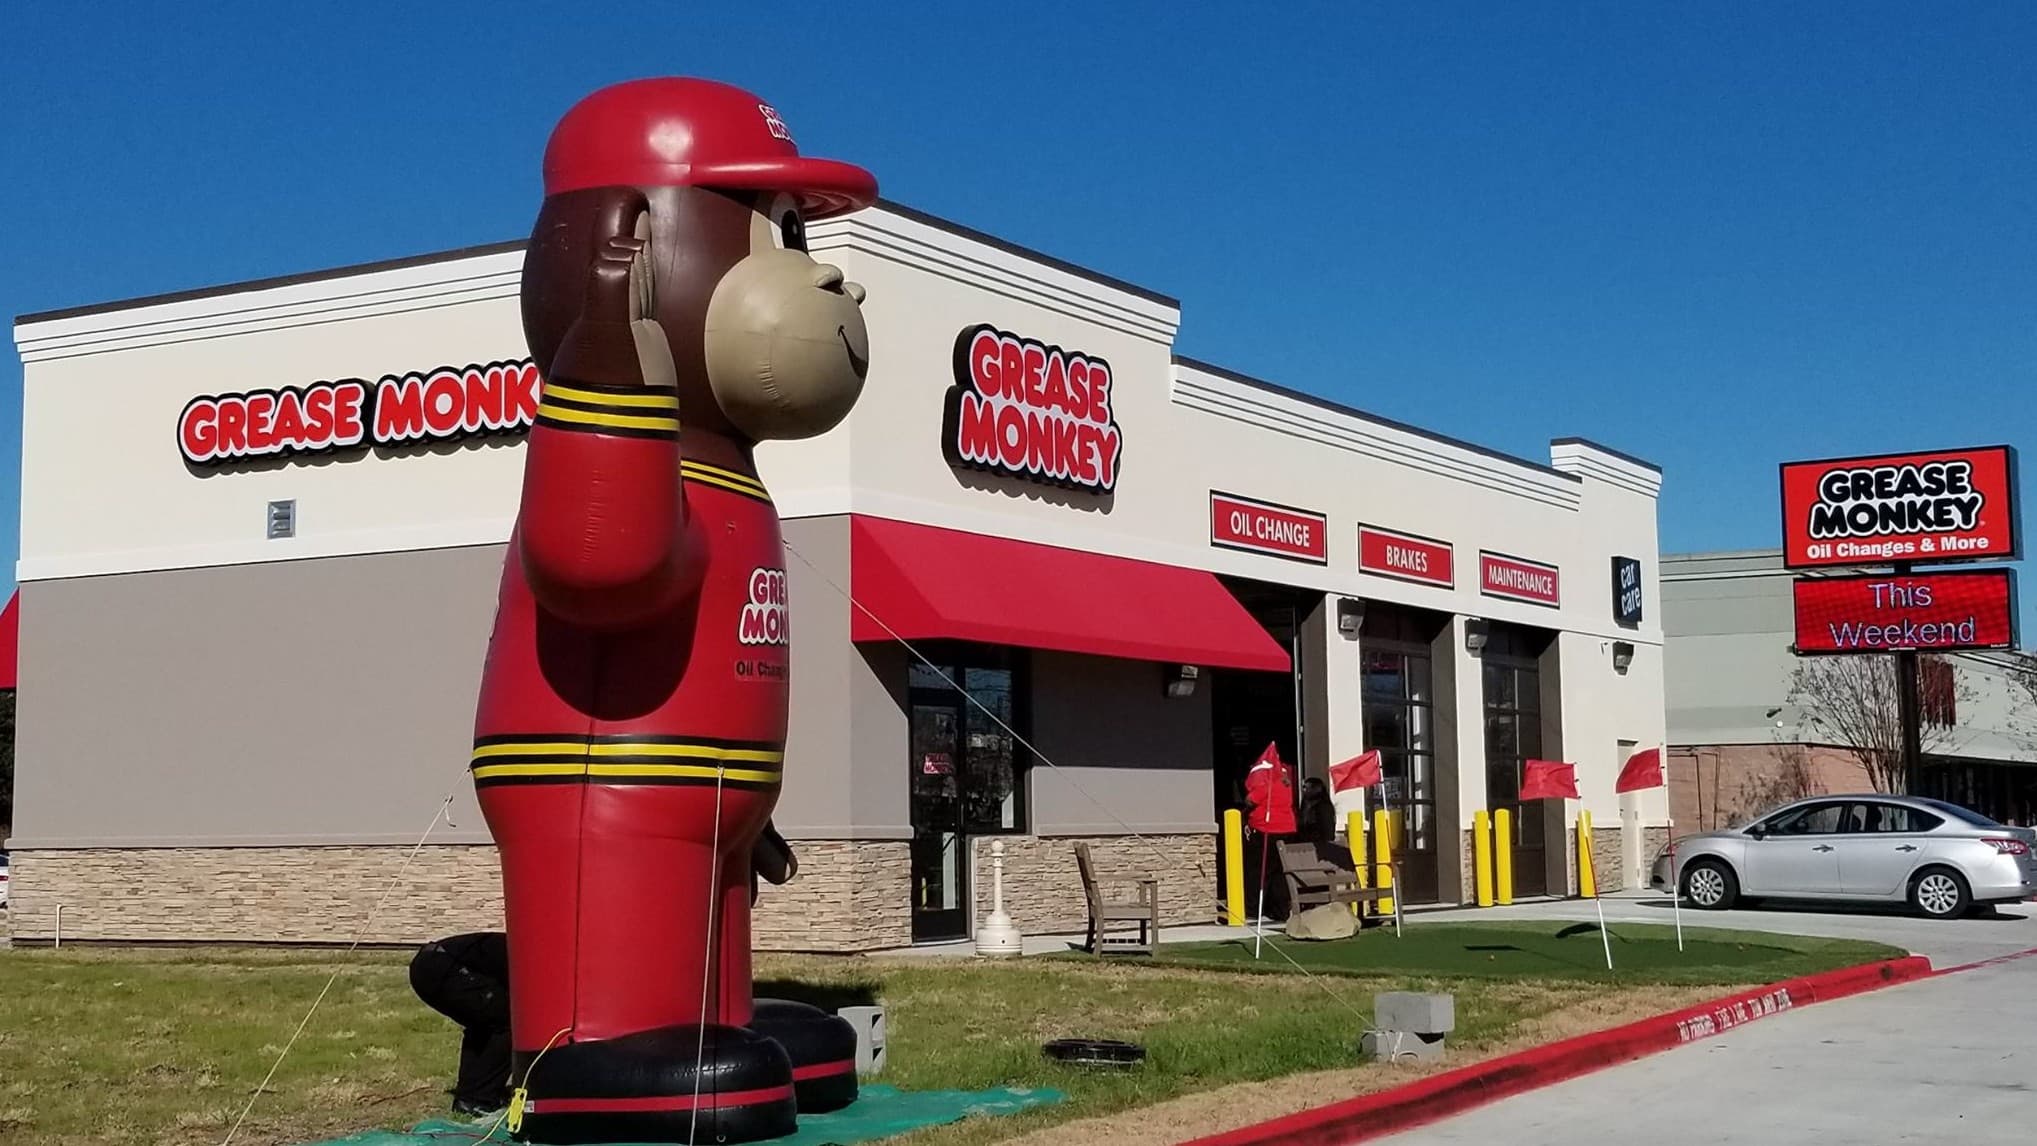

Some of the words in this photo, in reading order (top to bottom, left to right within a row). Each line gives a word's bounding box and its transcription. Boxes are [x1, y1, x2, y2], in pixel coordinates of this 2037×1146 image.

[971, 334, 1109, 426] GREASE
[183, 384, 362, 457] GREASE
[376, 363, 540, 438] MONK
[959, 394, 1119, 486] MONKEY
[1822, 464, 1970, 502] GREASE
[1230, 509, 1253, 538] OIL
[1256, 514, 1310, 548] CHANGE
[1811, 496, 1981, 537] MONKEY
[1386, 543, 1428, 573] BRAKES
[1807, 544, 1832, 559] Oil
[1836, 541, 1915, 557] Changes
[1920, 537, 1936, 551] &
[1941, 536, 1989, 551] More
[1488, 565, 1553, 596] MAINTENANCE
[1620, 563, 1635, 590] car
[1621, 586, 1641, 617] care
[1869, 582, 1932, 608] This
[1829, 617, 1975, 648] Weekend
